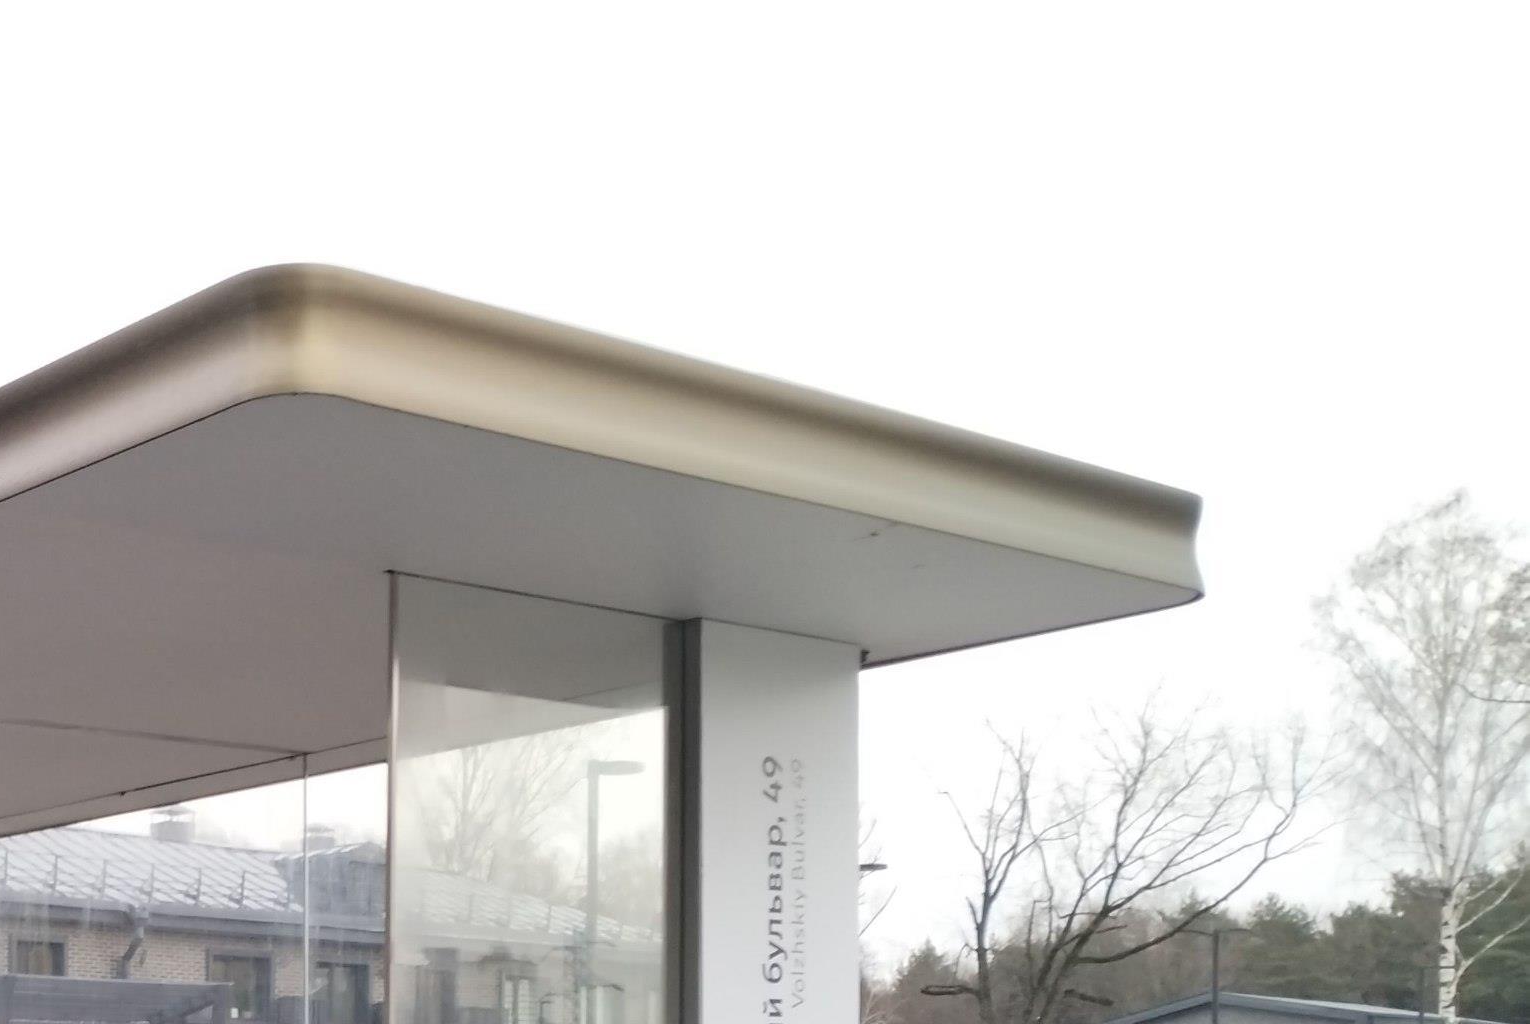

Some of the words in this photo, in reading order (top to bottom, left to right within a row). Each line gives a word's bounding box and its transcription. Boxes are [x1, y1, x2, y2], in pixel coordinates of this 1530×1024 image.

[761, 756, 784, 804] 49
[761, 815, 788, 984] бульвар,
[790, 890, 808, 1009] Volzhskiy
